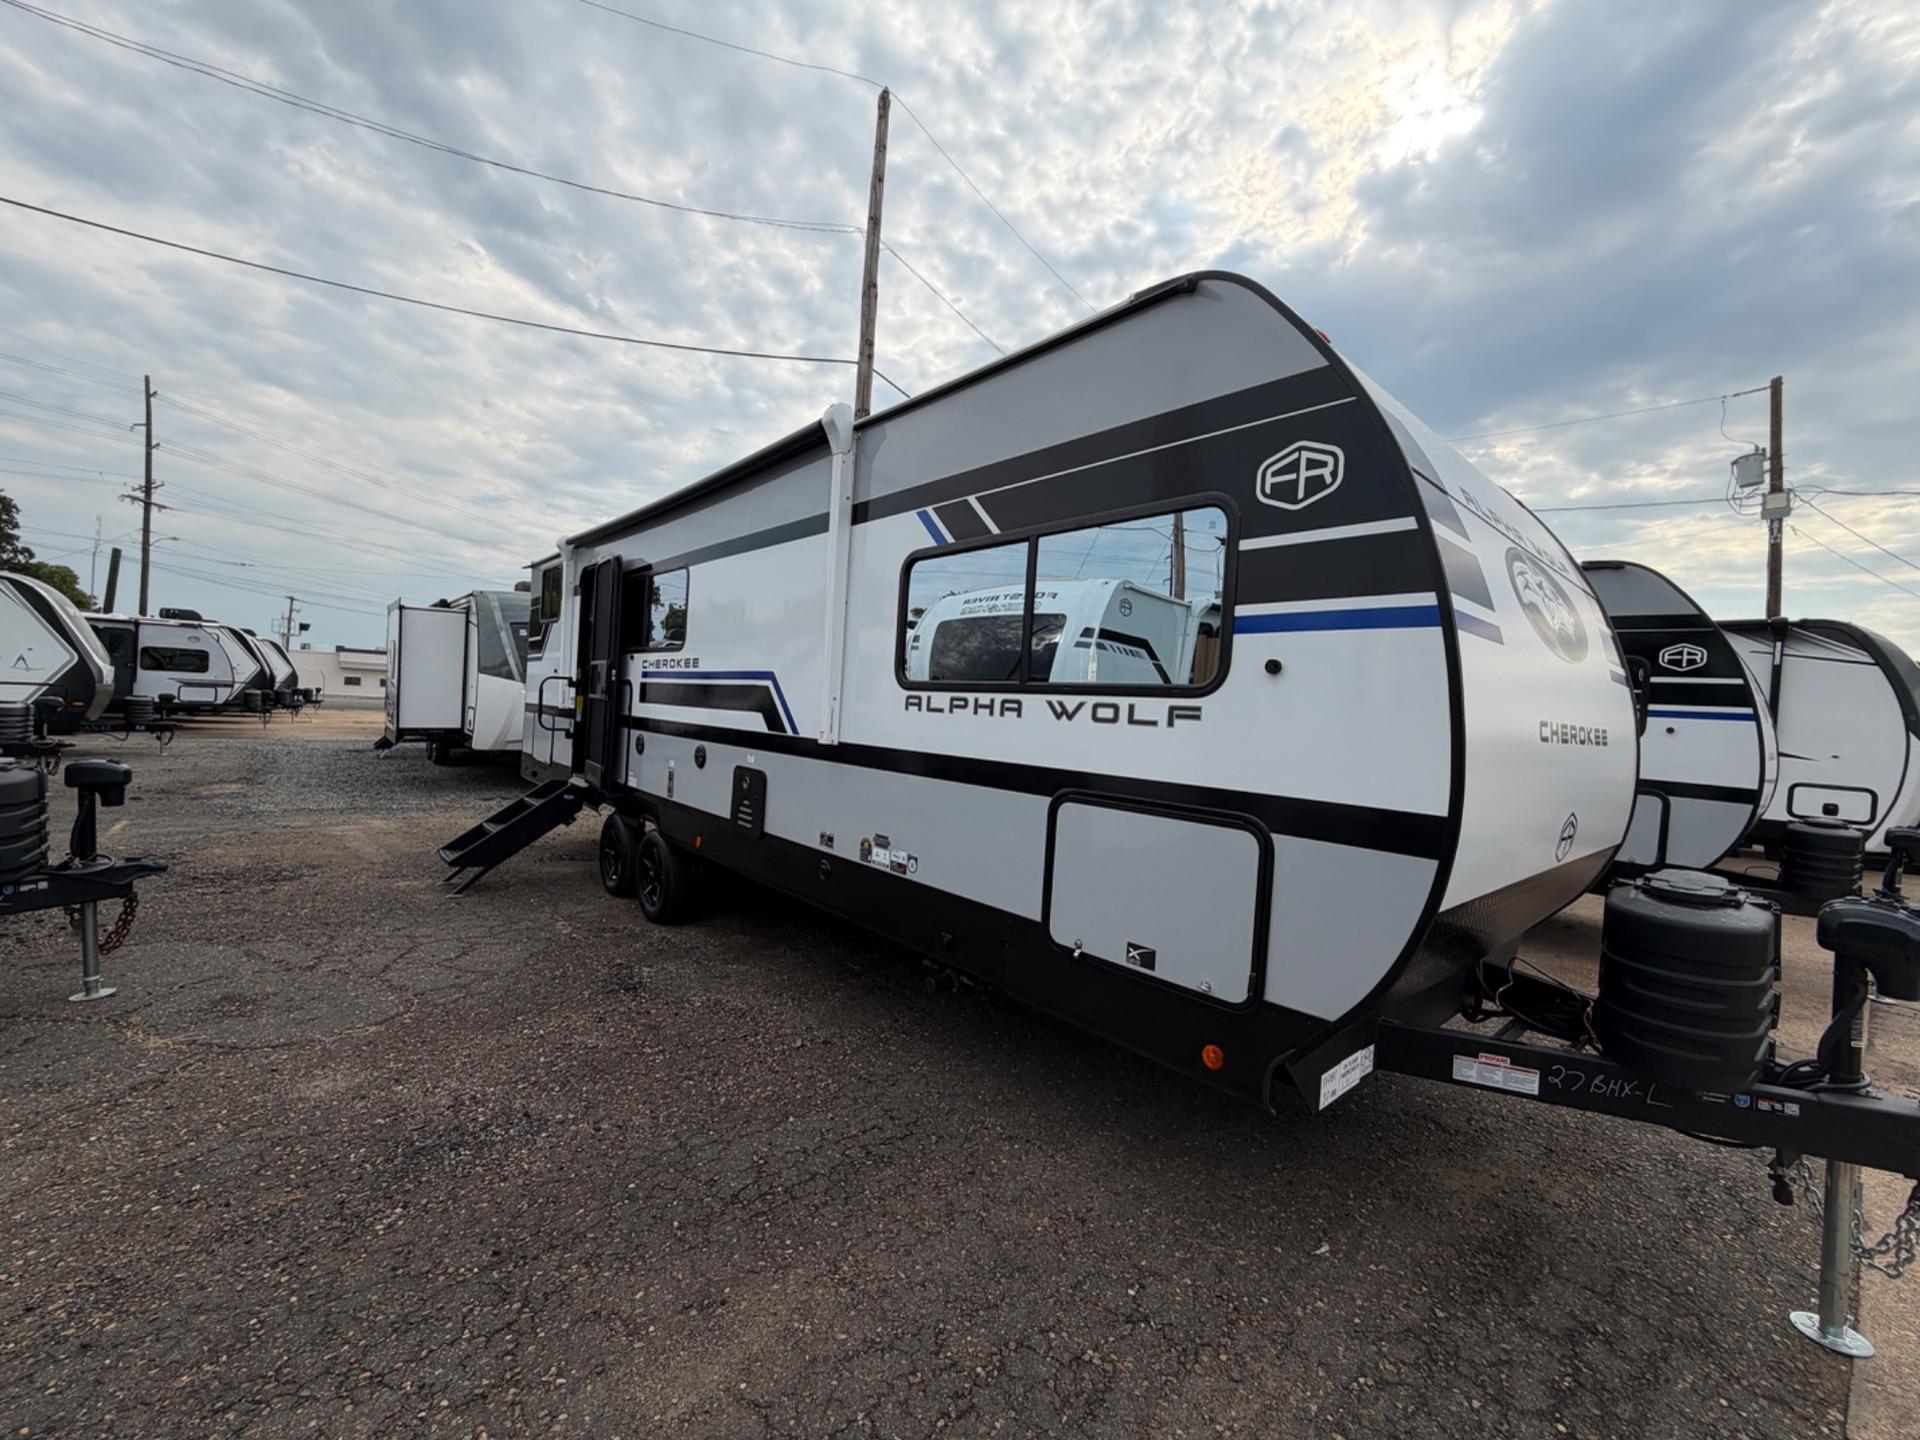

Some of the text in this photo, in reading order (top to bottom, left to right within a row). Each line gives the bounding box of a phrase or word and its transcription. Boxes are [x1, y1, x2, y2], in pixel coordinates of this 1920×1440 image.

[642, 657, 700, 669] CHEROKEE
[904, 694, 1203, 728] ALPHA WOLF
[1540, 720, 1608, 747] CHEROKEE
